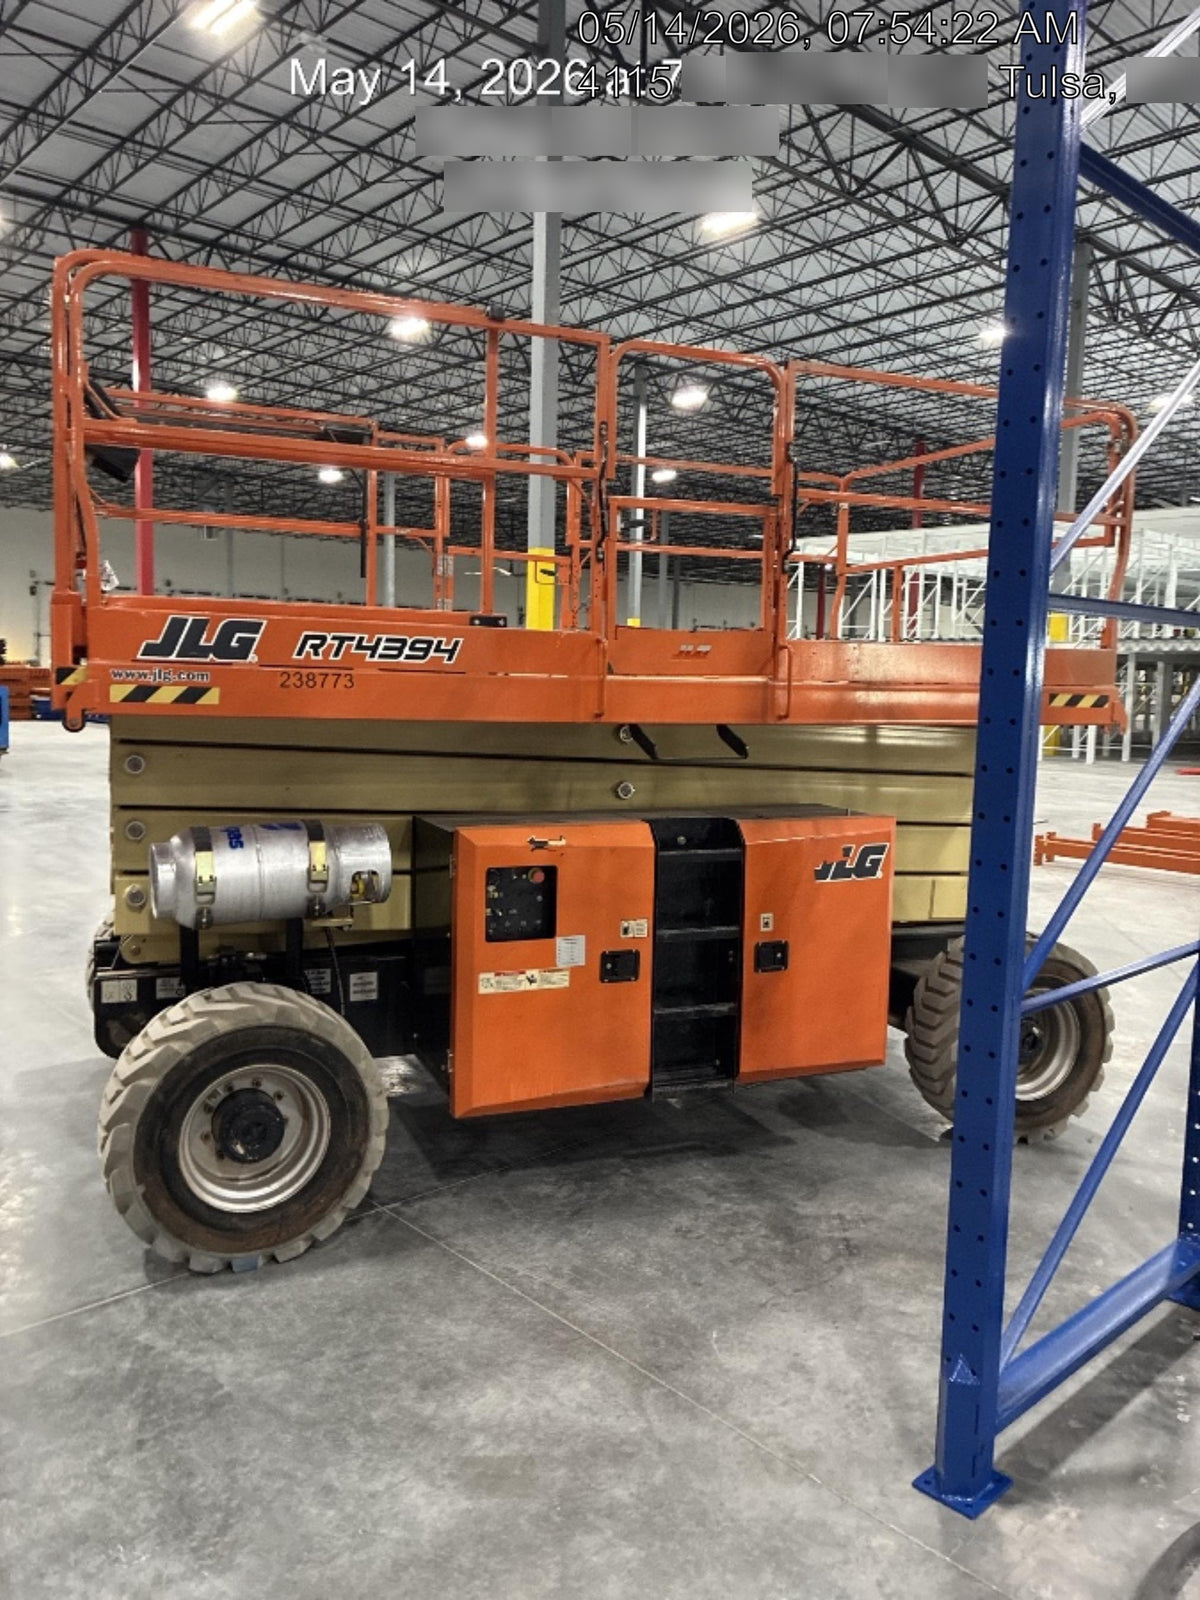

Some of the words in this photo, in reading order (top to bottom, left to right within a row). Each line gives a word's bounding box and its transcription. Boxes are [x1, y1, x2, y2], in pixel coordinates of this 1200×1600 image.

[137, 615, 266, 662] JLG
[294, 632, 463, 664] RT4394
[110, 667, 211, 684] www.jlg.com
[280, 671, 355, 689] 238773
